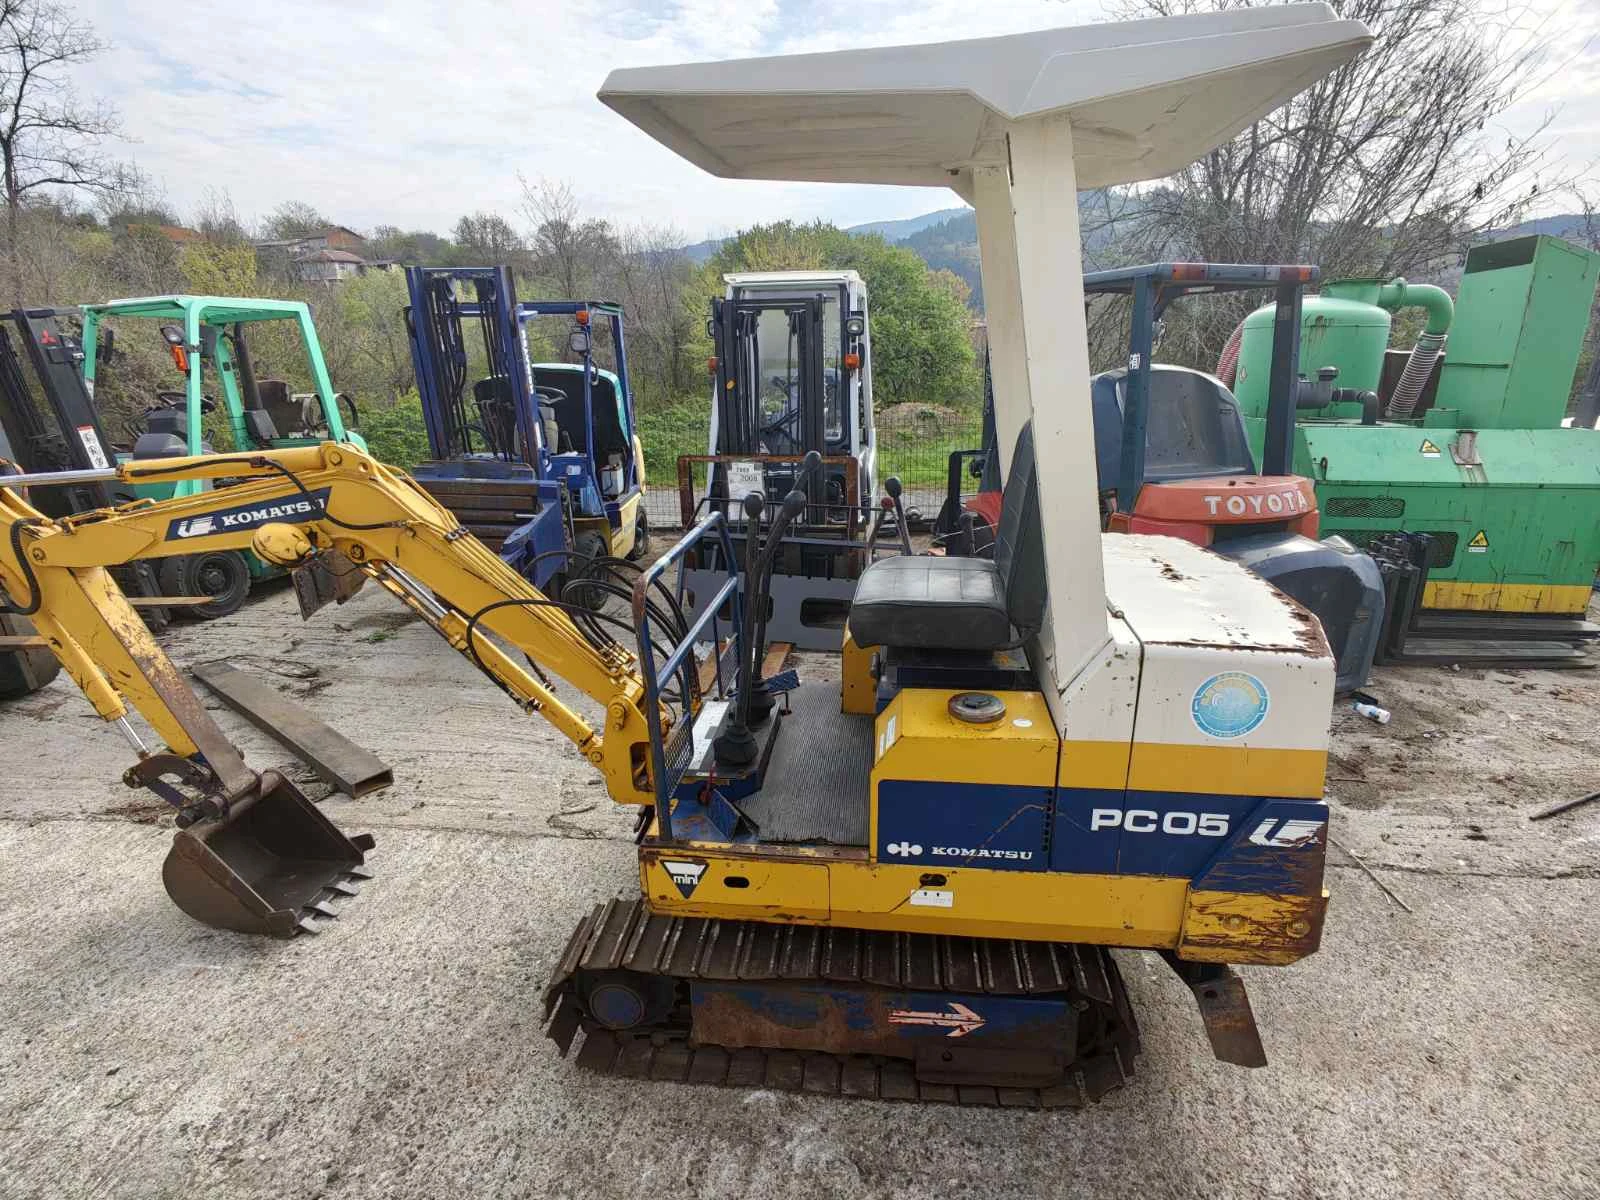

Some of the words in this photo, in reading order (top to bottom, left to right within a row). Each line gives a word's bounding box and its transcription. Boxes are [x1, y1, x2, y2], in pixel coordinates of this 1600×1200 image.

[1204, 490, 1307, 516] TOYOTA
[1090, 808, 1230, 837] PC05
[931, 846, 1033, 861] KOMATSU
[673, 874, 698, 885] mini
